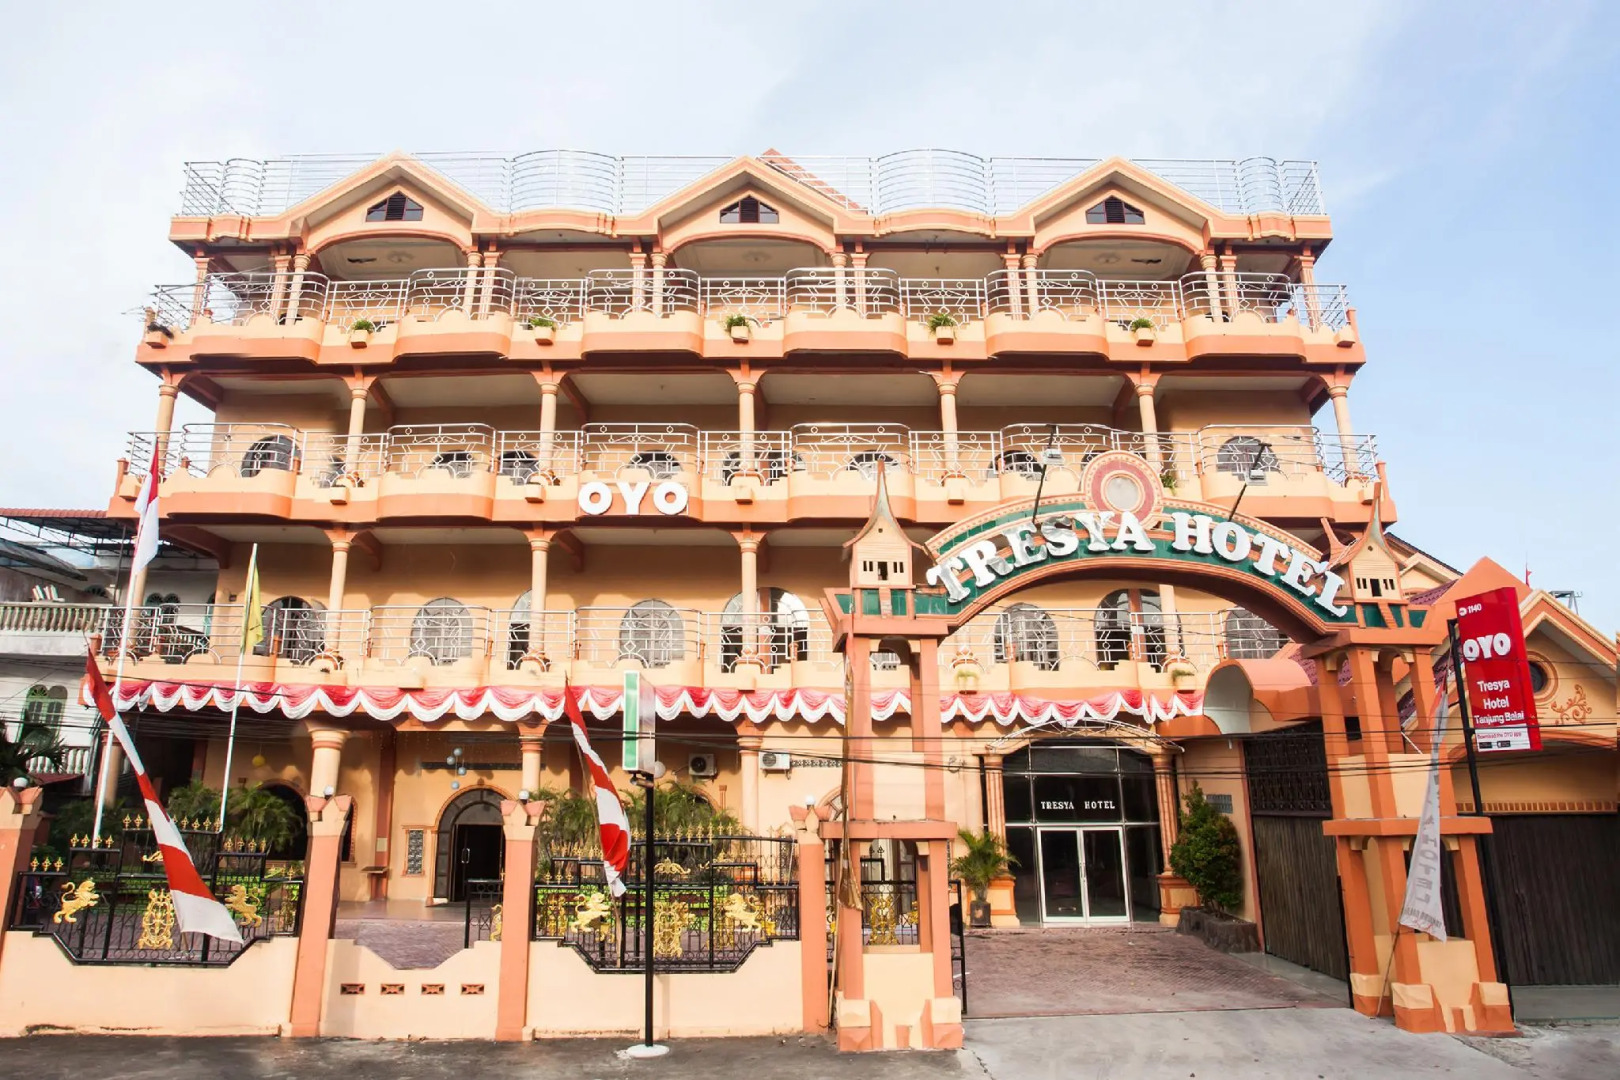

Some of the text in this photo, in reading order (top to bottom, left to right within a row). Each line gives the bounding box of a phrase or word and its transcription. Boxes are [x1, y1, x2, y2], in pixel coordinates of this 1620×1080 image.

[578, 481, 688, 515] OYO
[925, 510, 1348, 618] TRESYA HOTEL
[1467, 603, 1482, 614] 1140
[1463, 632, 1511, 661] OYO
[1477, 678, 1510, 693] Tresya
[1483, 696, 1509, 710] Hotel
[1474, 710, 1525, 725] Tanjung Balai
[1040, 800, 1116, 810] TRESYA HOTEL
